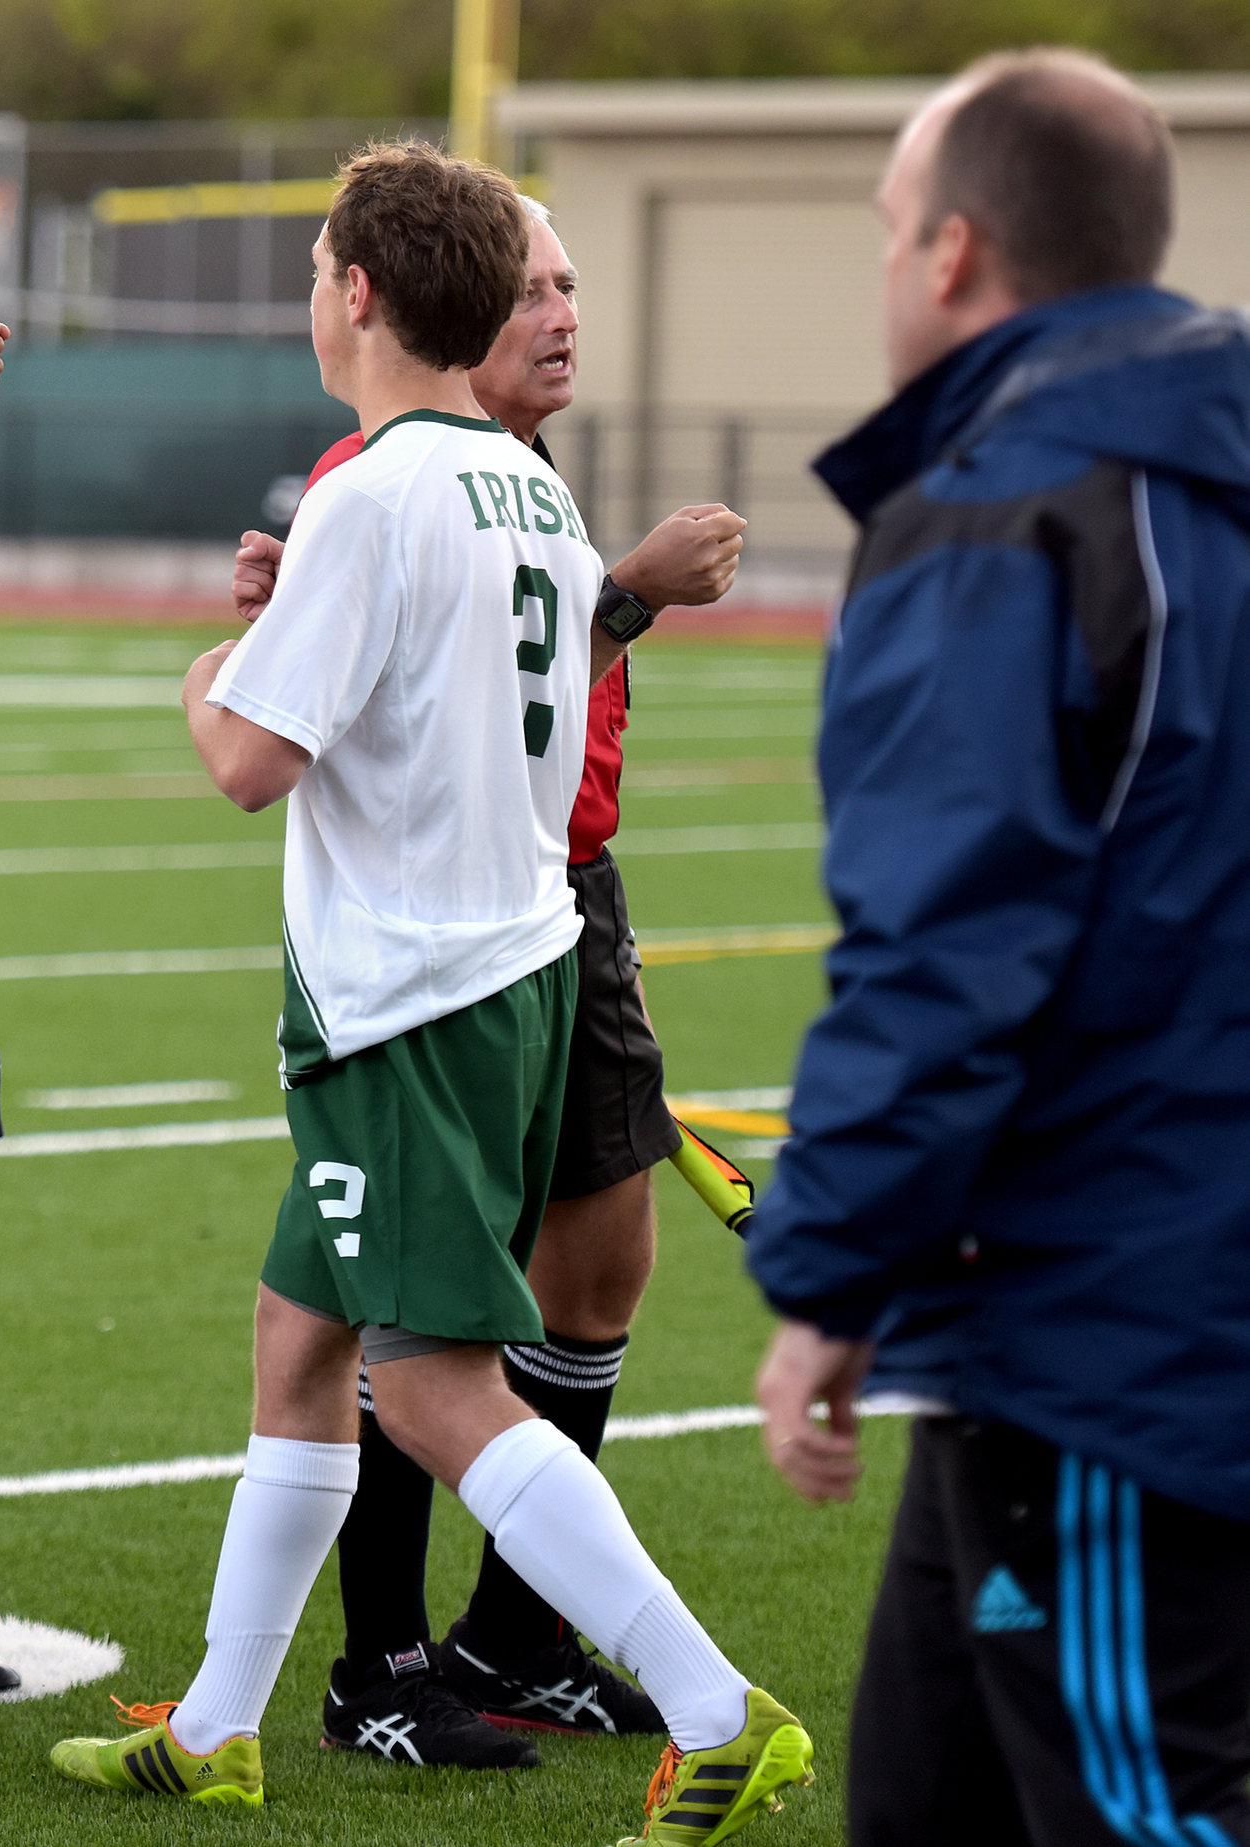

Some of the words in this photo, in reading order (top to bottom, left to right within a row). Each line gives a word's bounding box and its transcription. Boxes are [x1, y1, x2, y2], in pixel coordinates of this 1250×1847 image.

[456, 471, 589, 546] IRISH
[513, 564, 558, 758] 2
[309, 1161, 366, 1257] 2
